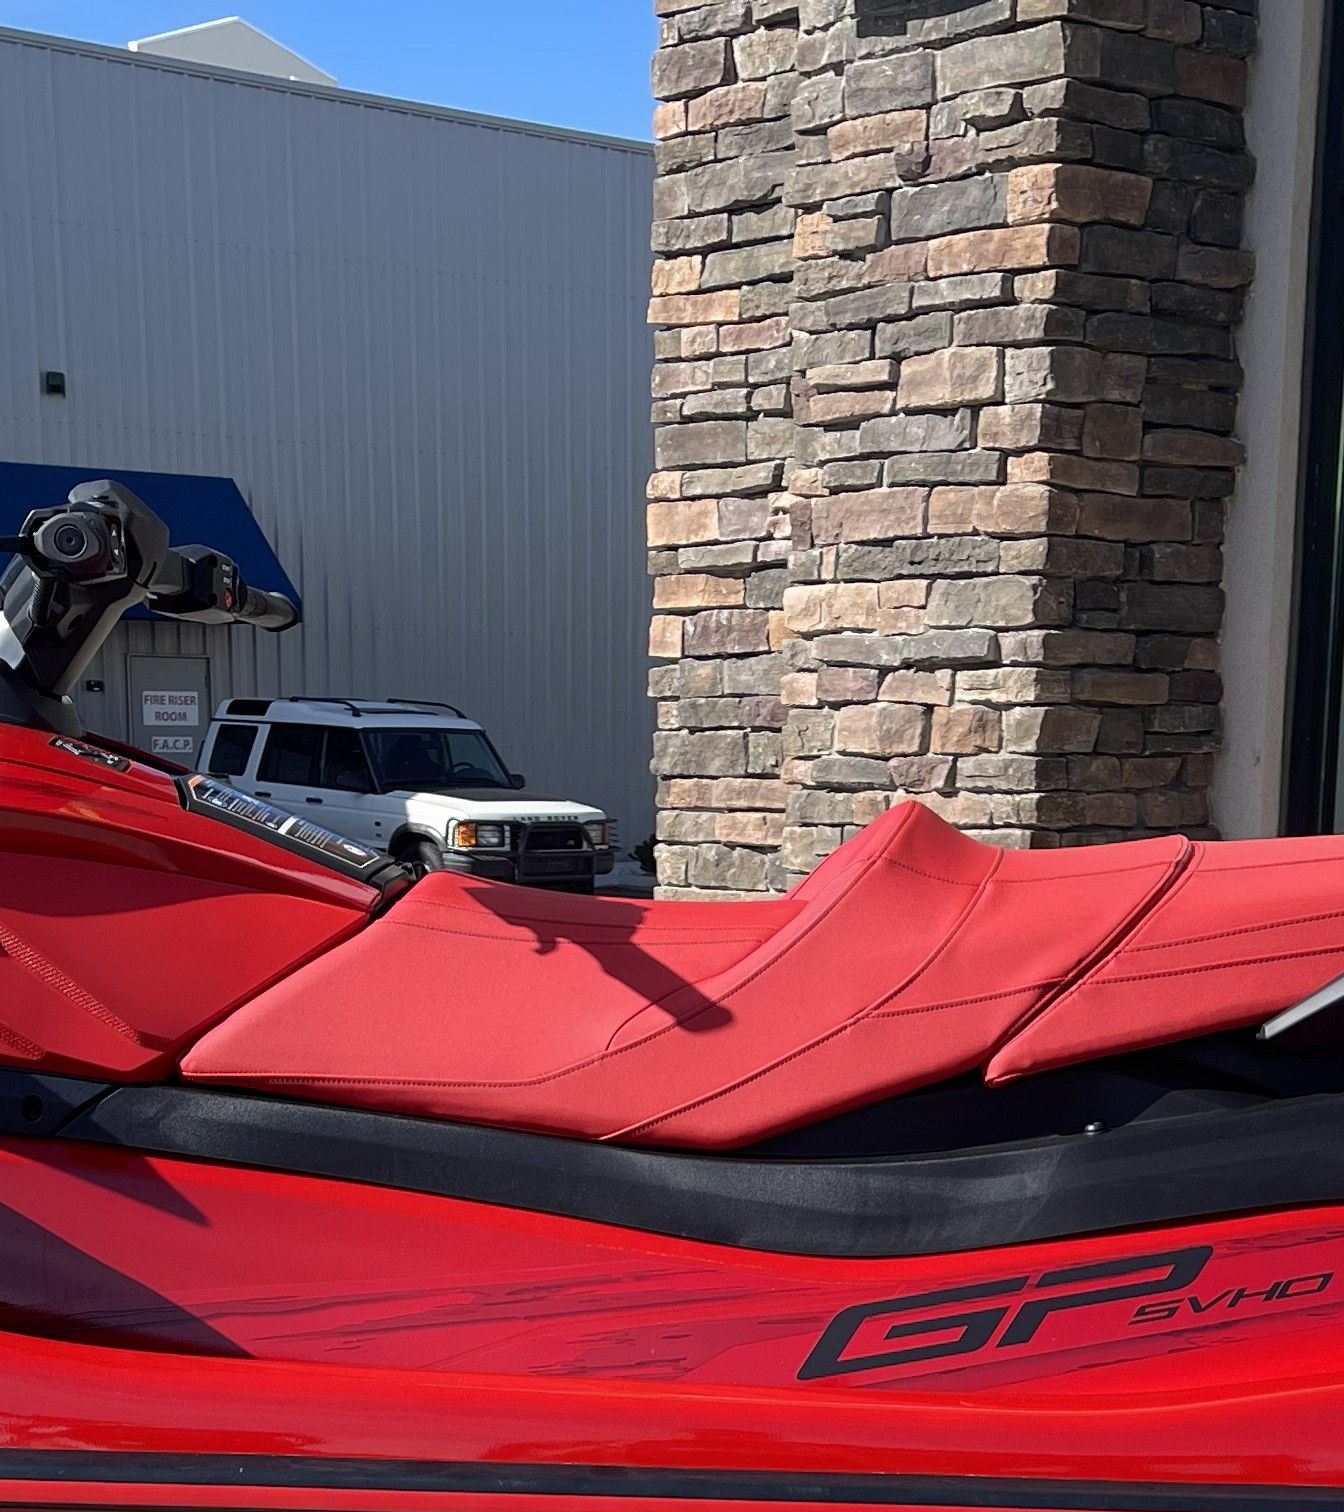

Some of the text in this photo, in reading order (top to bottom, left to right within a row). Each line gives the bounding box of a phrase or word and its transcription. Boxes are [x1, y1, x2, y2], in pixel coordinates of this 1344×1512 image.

[144, 695, 196, 706] FIRE RISER
[155, 711, 187, 721] ROOM
[796, 1245, 1214, 1381] GP
[1128, 1272, 1335, 1326] SVHO
